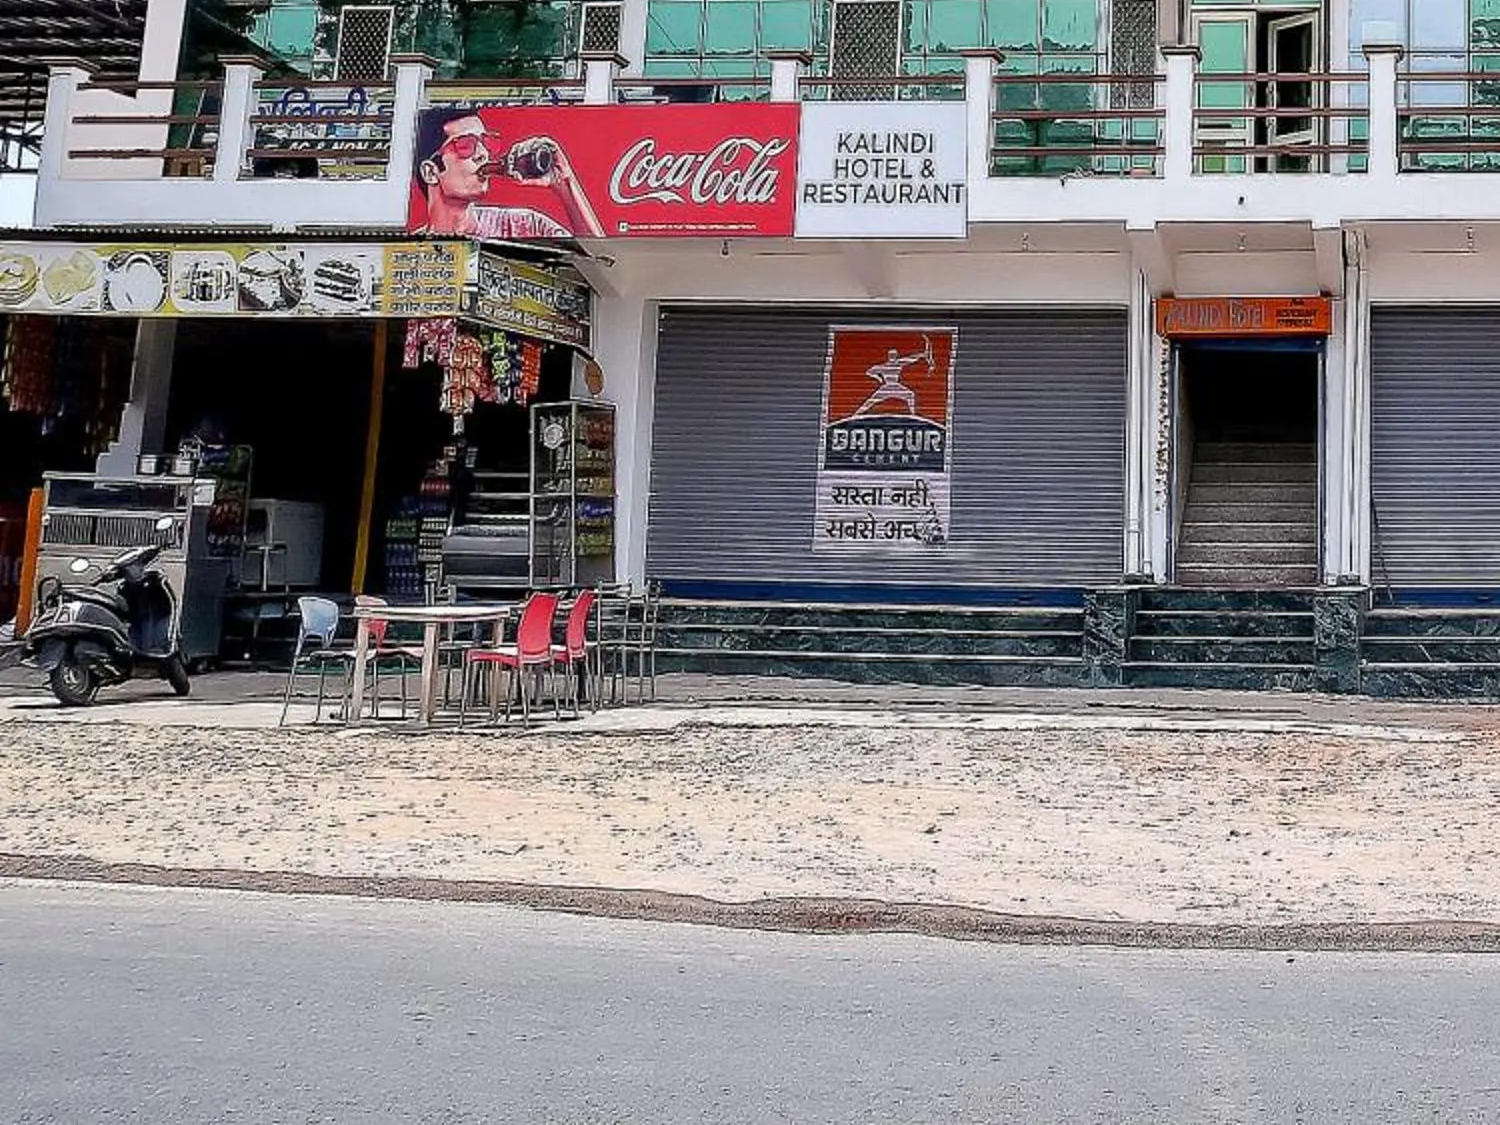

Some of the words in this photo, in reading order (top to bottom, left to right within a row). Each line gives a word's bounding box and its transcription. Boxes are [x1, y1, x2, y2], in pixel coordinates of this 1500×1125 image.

[837, 133, 934, 154] KALINDI
[609, 135, 791, 204] Coca-Cola
[834, 158, 912, 179] HOTEL
[921, 158, 936, 179] &
[803, 183, 965, 205] RESTAURANT
[831, 428, 941, 452] BANGUR
[831, 486, 883, 506] सस्ता
[826, 513, 877, 540] सबसे
